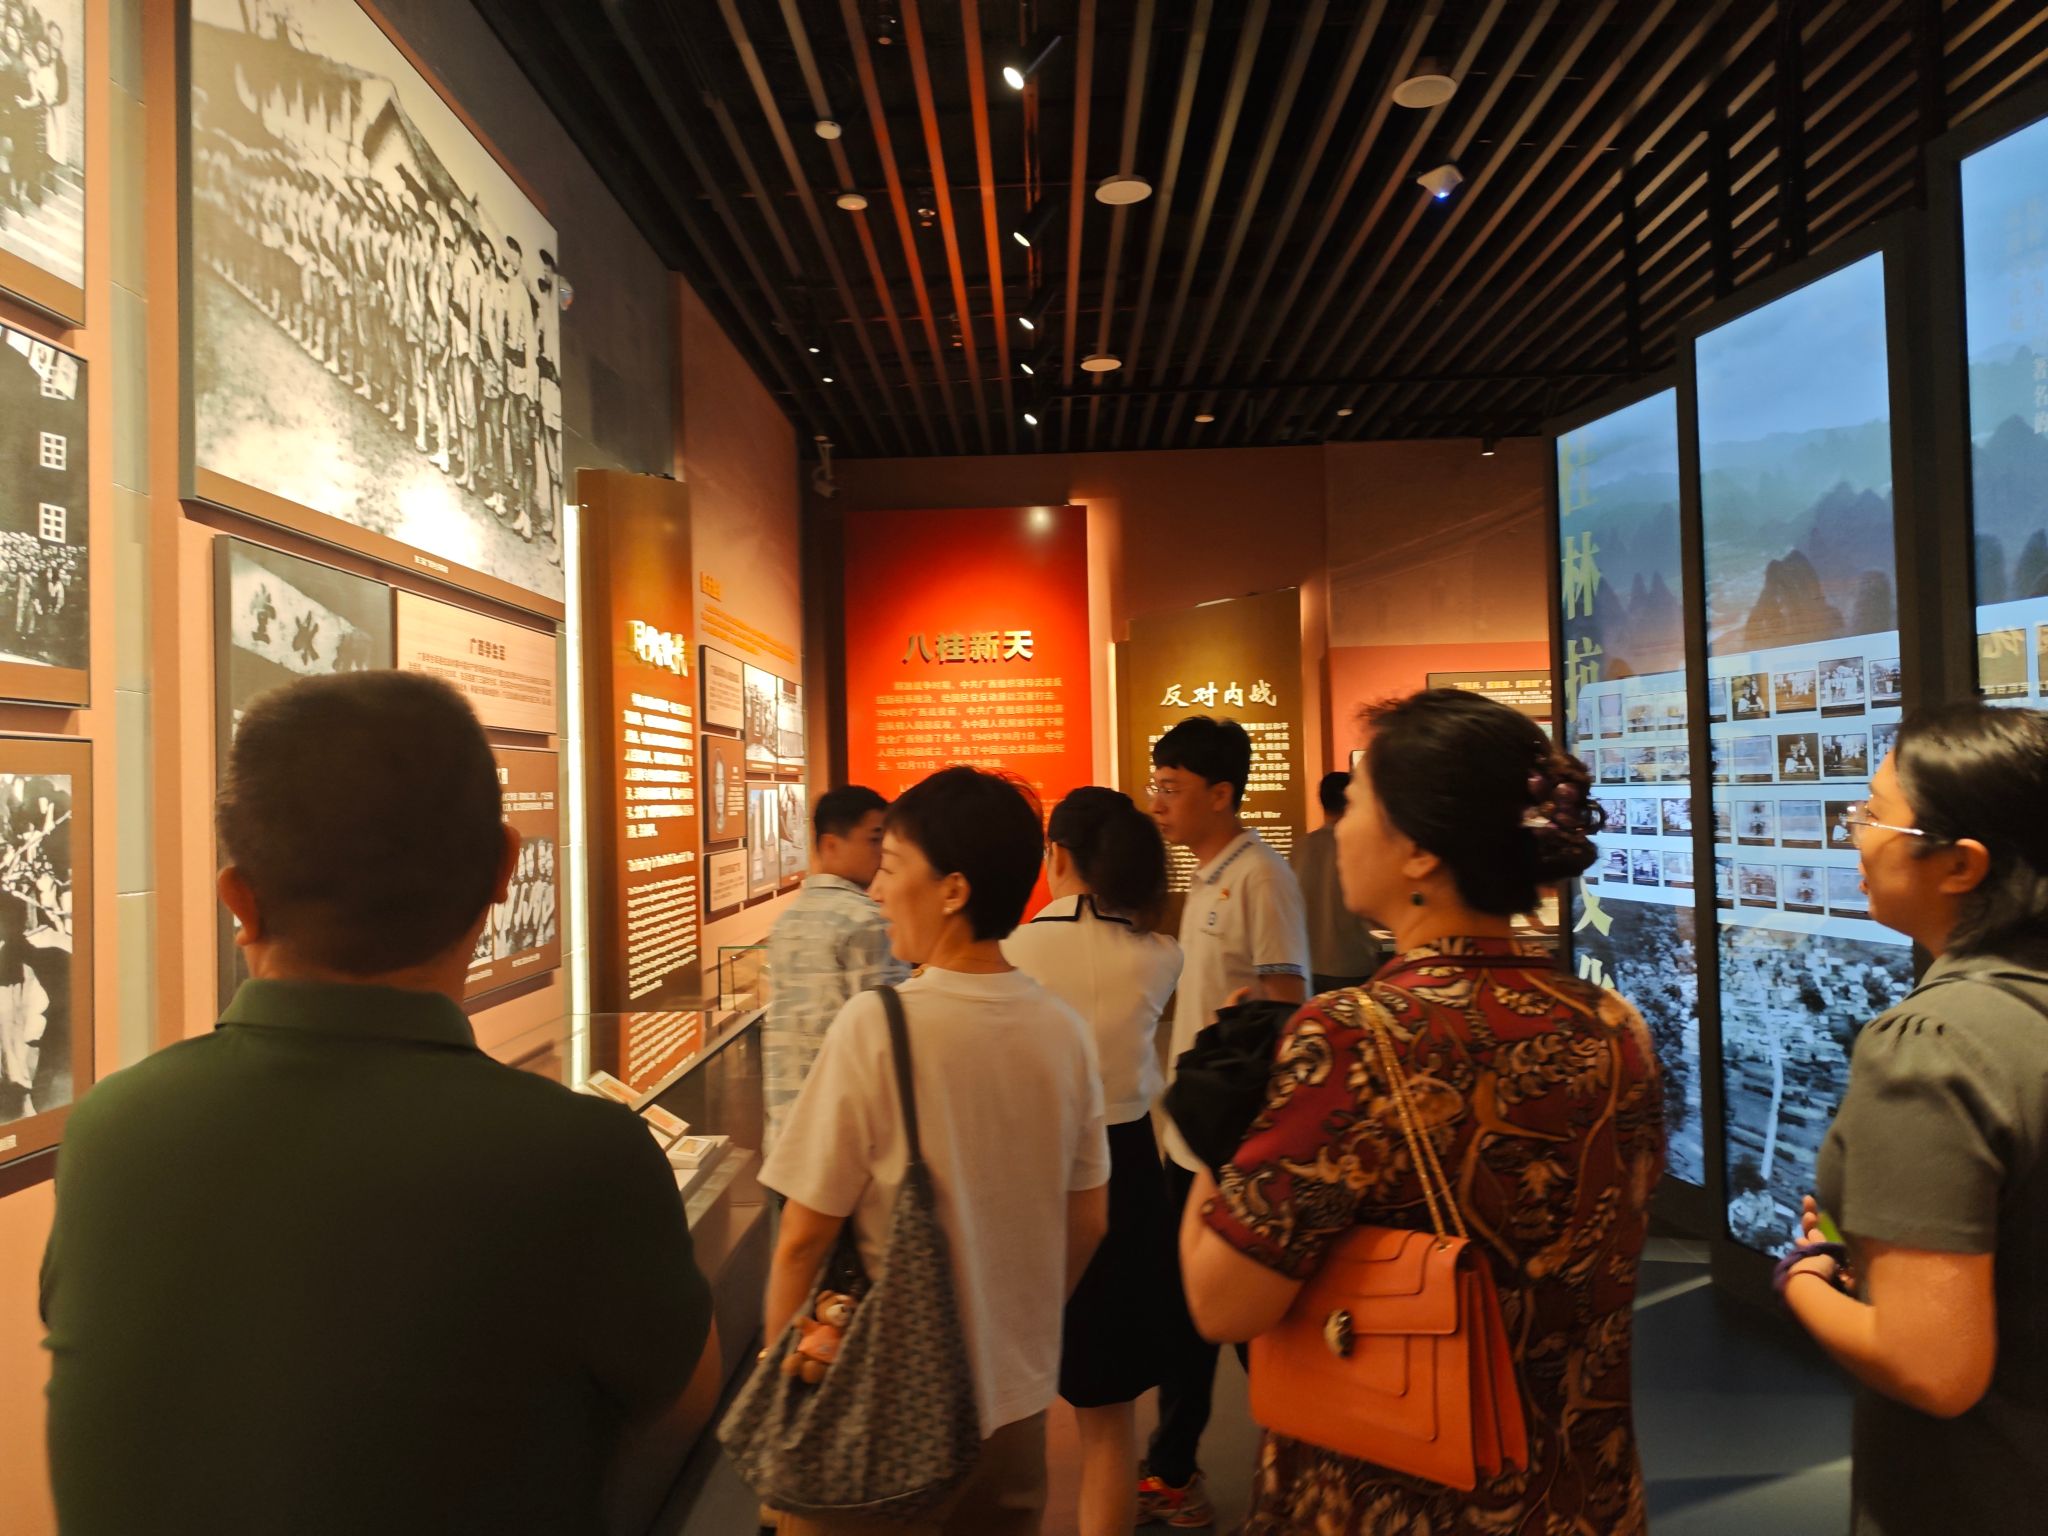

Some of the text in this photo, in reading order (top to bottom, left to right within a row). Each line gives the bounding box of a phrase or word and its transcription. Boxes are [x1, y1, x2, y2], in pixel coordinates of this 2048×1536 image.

[902, 630, 1034, 664] 八桂新天
[1160, 679, 1277, 708] 反对内战
[1263, 811, 1282, 819] War
